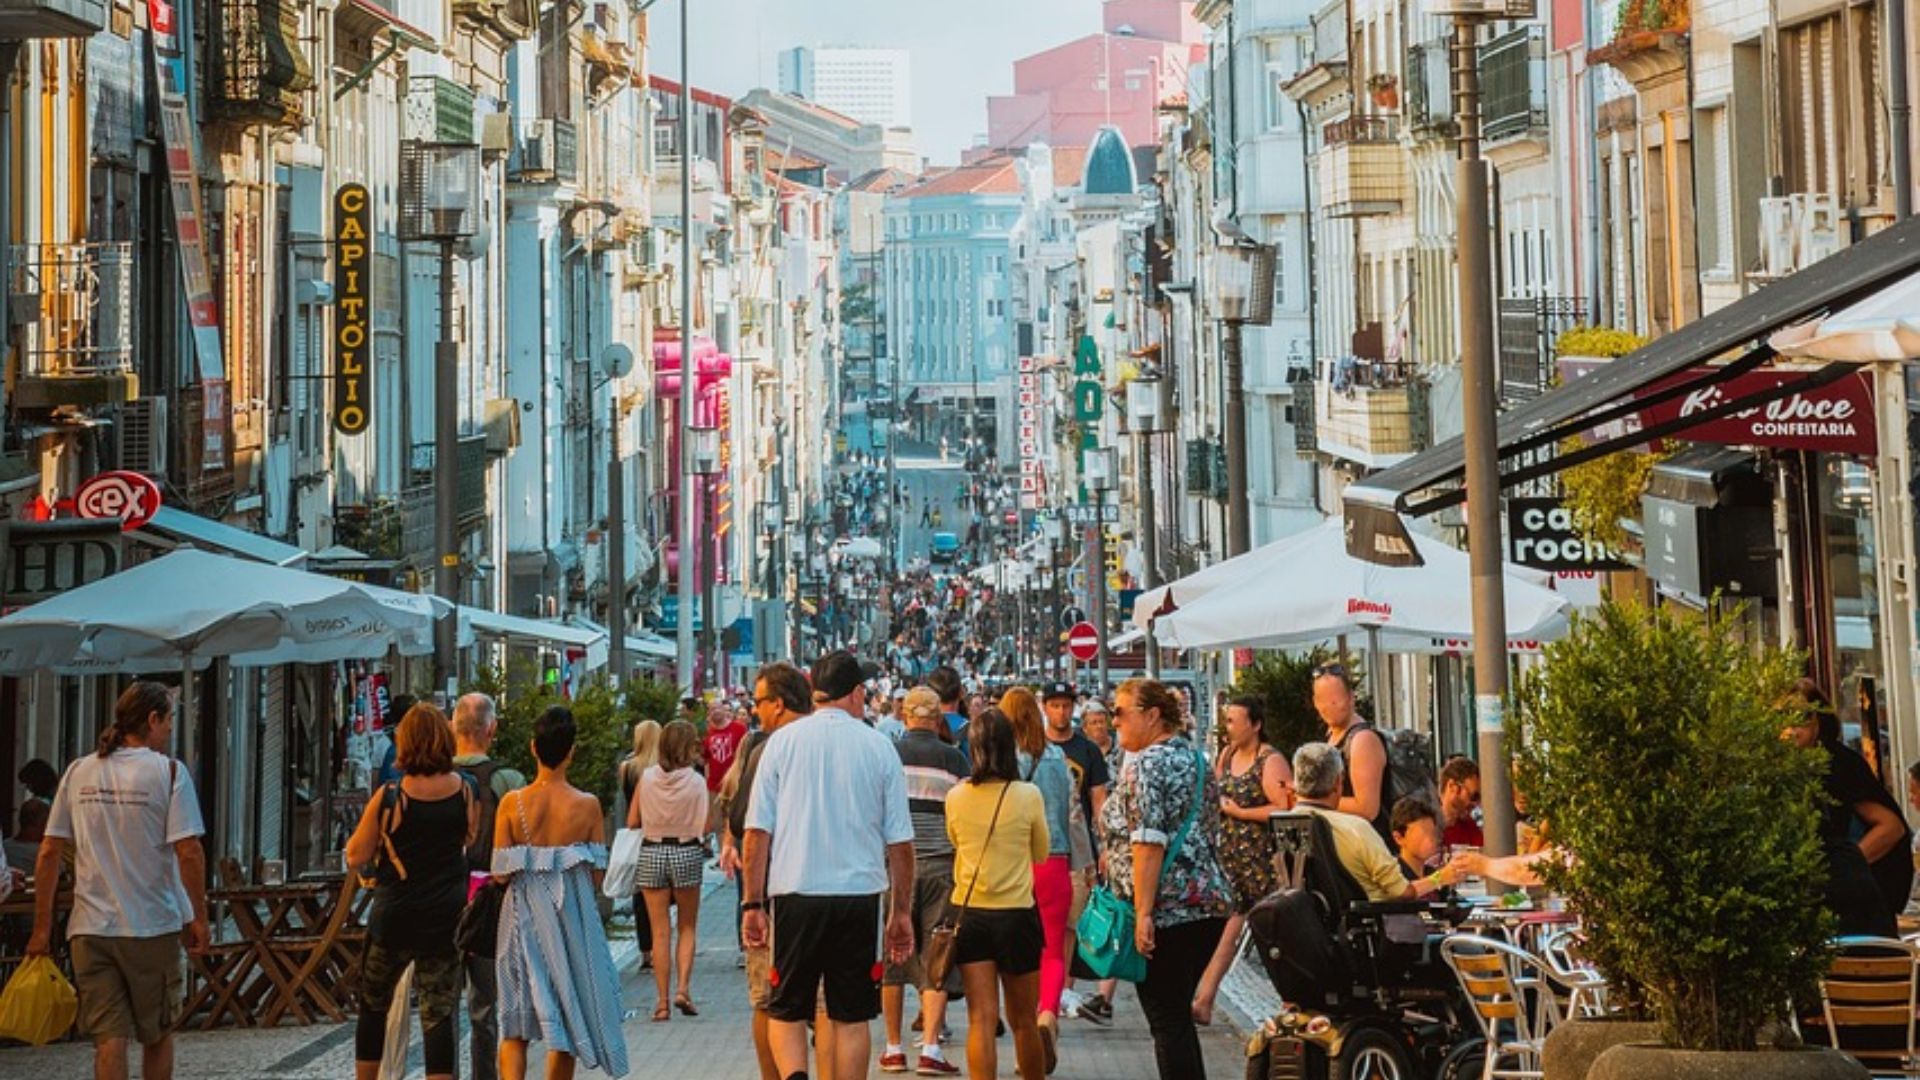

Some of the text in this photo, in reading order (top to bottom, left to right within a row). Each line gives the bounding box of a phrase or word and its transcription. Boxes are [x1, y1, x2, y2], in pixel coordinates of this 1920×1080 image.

[339, 189, 366, 430] CAPITÓLIO
[1021, 359, 1034, 489] PERFECTA
[1751, 423, 1857, 436] CONFEITARIA
